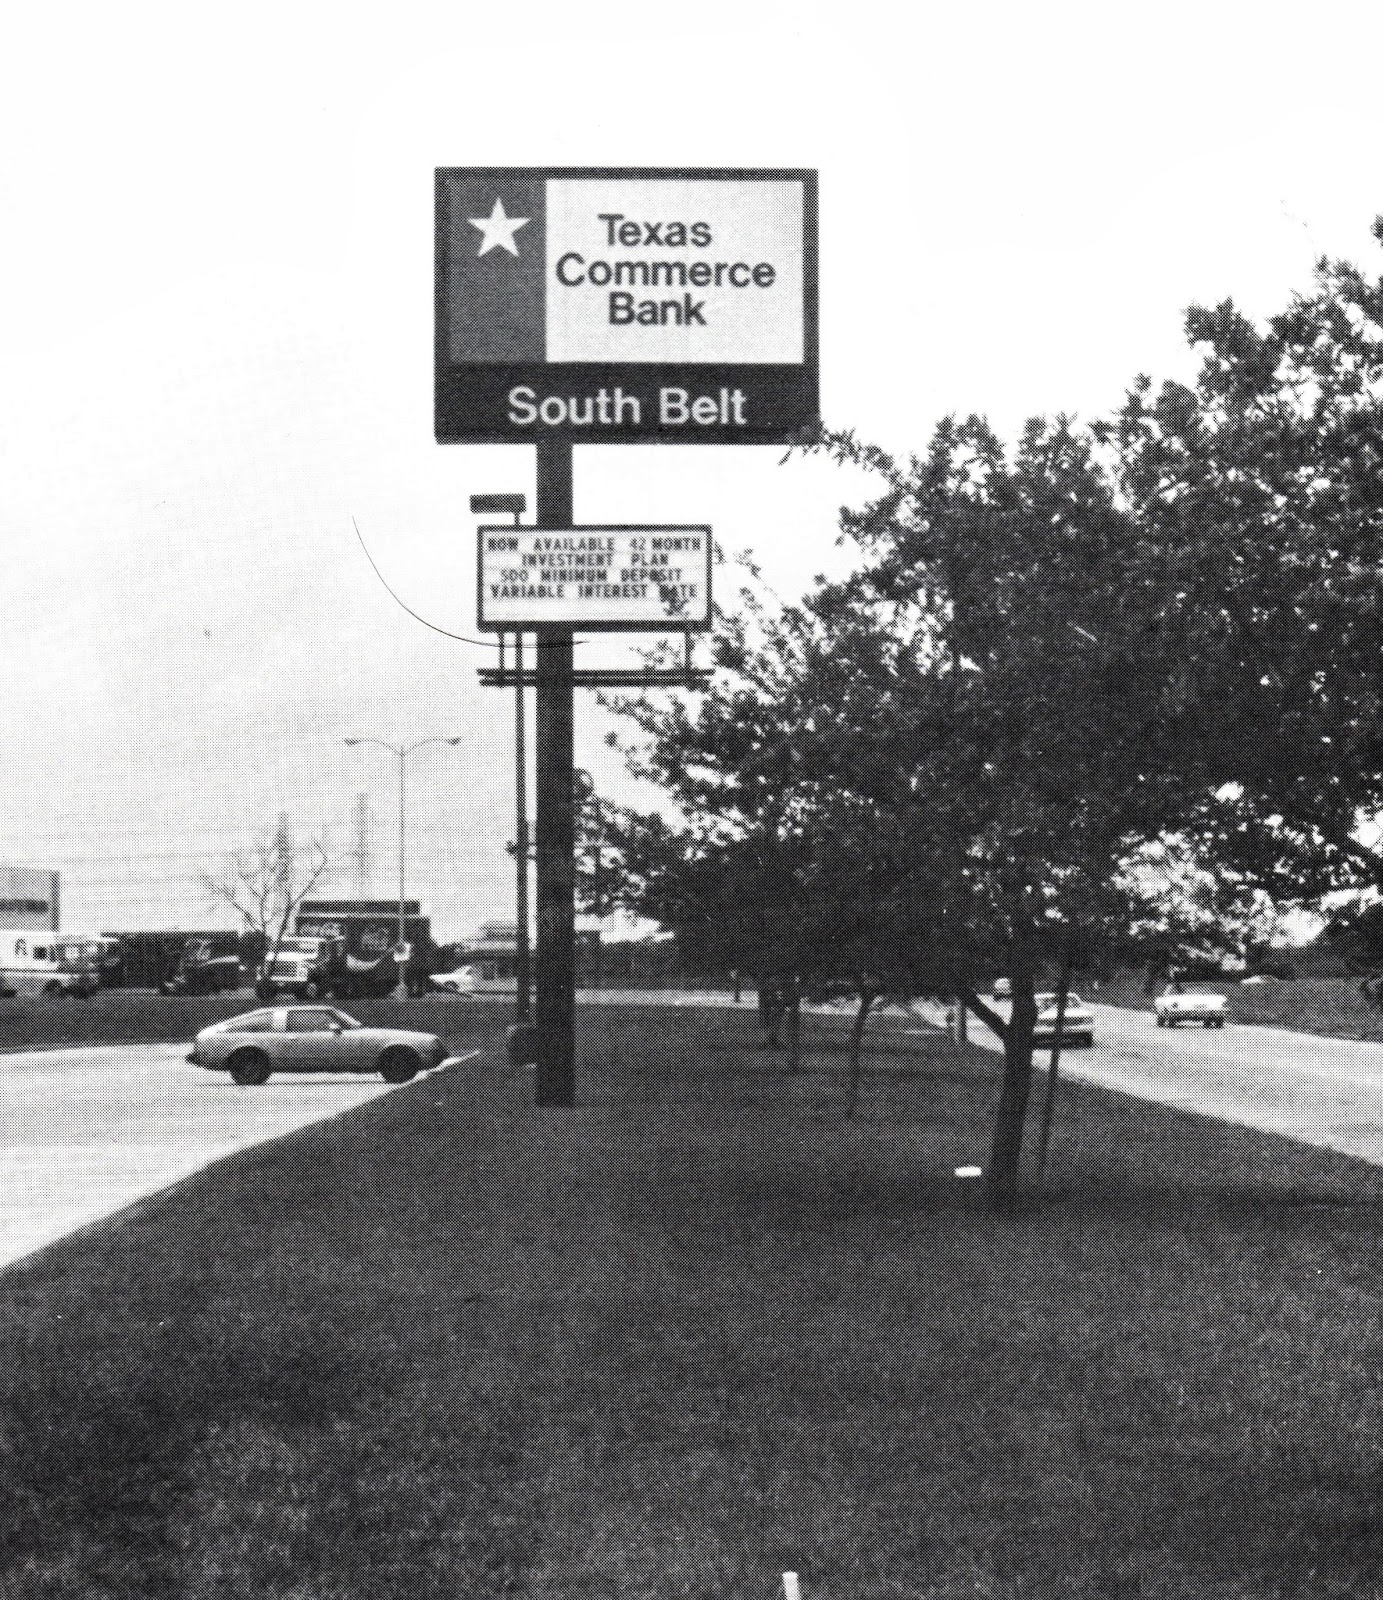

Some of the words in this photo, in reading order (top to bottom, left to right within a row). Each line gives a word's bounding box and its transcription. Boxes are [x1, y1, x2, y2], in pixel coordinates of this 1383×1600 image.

[597, 213, 713, 248] Texas
[555, 251, 777, 288] Commerce
[608, 291, 708, 326] Bank
[508, 385, 641, 426] South
[659, 386, 748, 426] Belt
[487, 537, 519, 552] NOW
[533, 537, 615, 552] AVAILABLE
[629, 537, 647, 551] 42
[652, 537, 701, 551] MONTH
[521, 552, 614, 567] INVESTMENT
[630, 552, 669, 567] PLAN
[501, 568, 530, 583] 500
[540, 568, 608, 583] MINIMUM
[490, 583, 564, 599] VARIABLE
[577, 583, 648, 599] INTEREST
[659, 583, 698, 600] ATE
